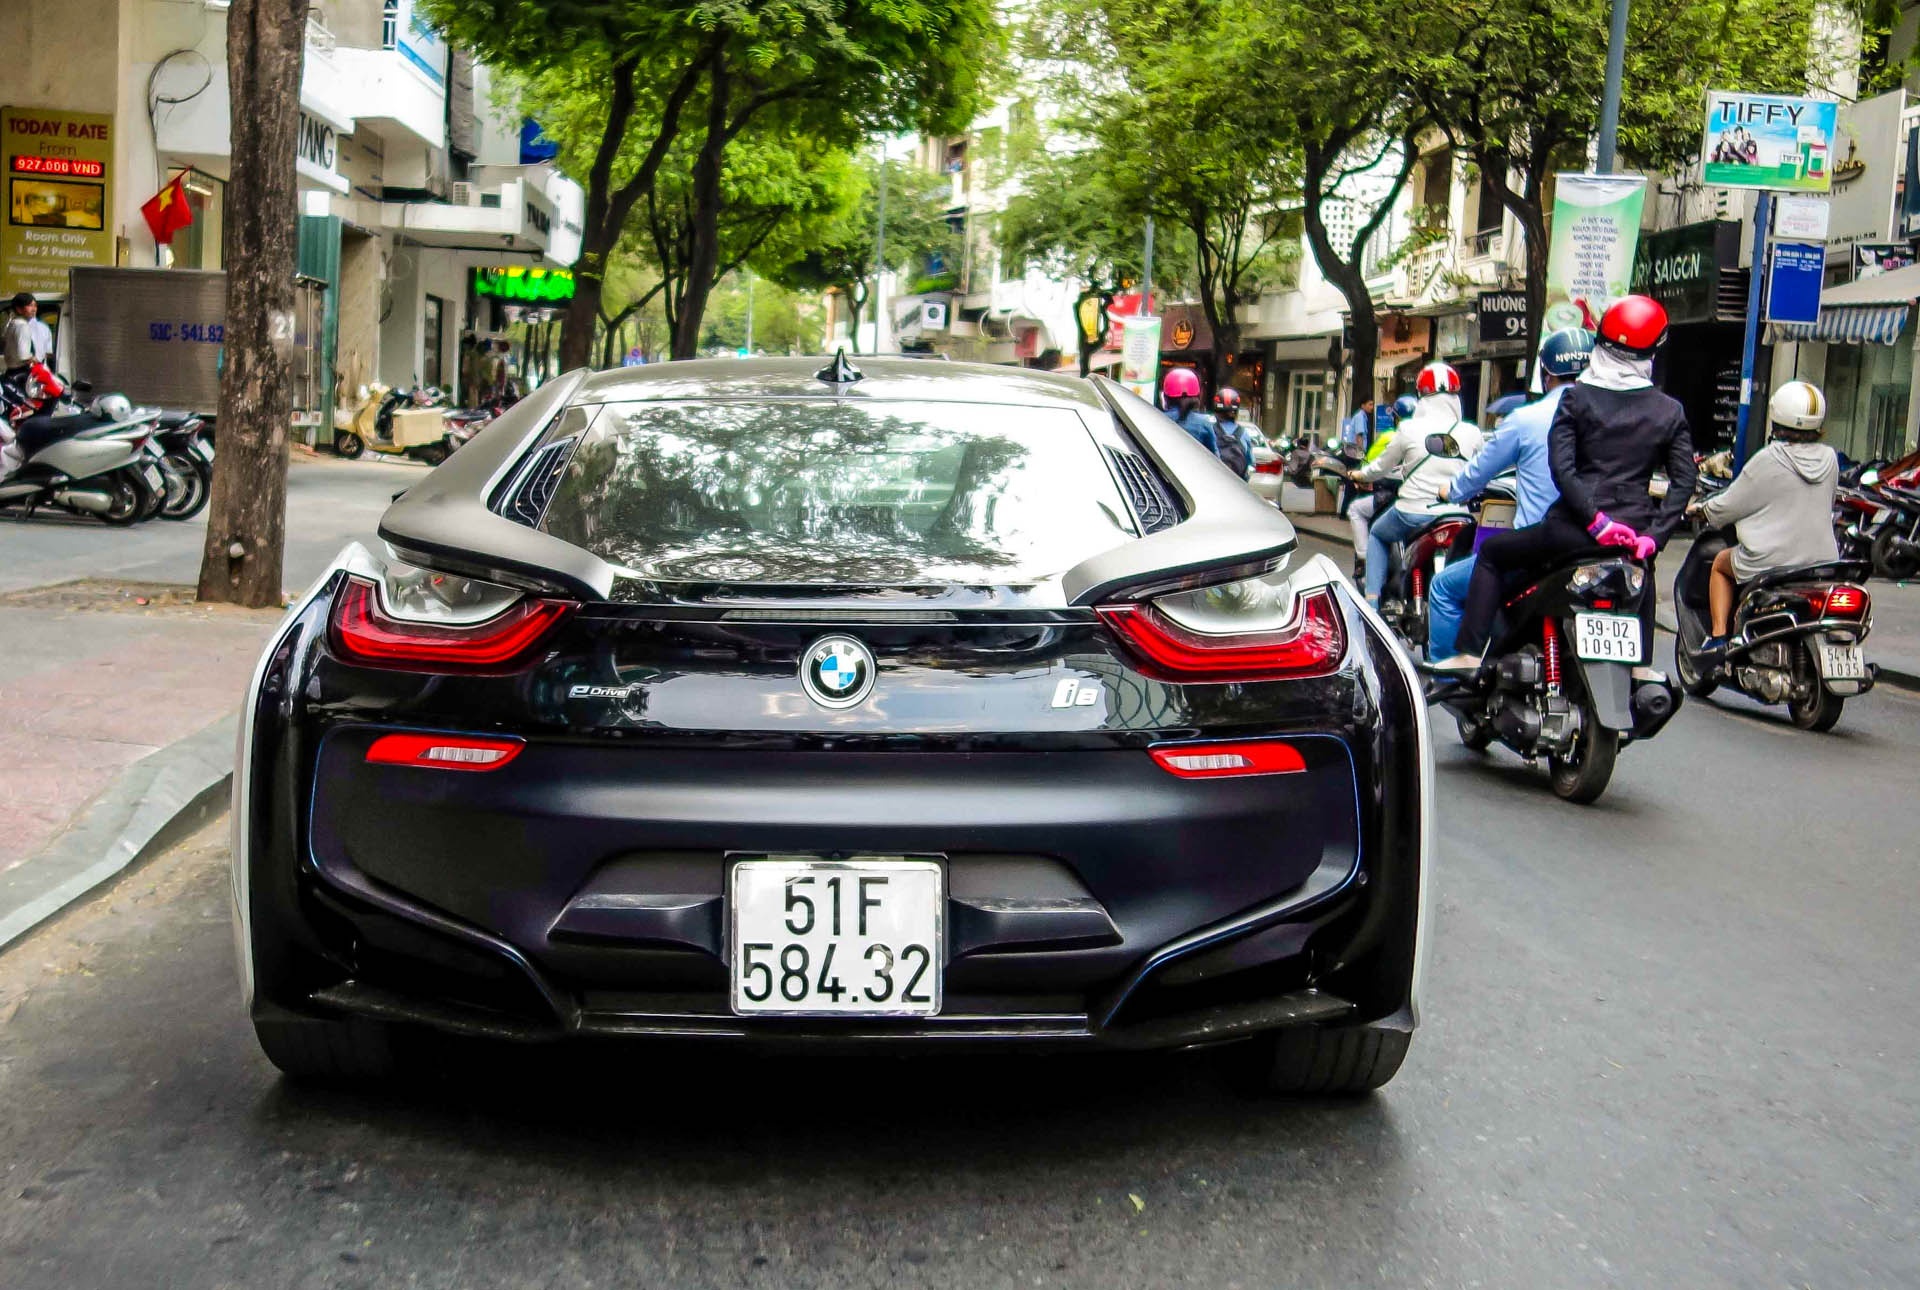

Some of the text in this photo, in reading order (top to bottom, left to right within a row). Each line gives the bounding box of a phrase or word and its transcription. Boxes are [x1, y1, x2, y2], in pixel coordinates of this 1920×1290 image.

[1718, 100, 1804, 126] TIFFY
[9, 117, 108, 139] TODAY RATE
[39, 141, 77, 156] From
[18, 159, 101, 175] 927.000 VND
[25, 230, 87, 245] Room Only
[27, 247, 39, 256] or
[41, 246, 48, 257] 2
[51, 247, 94, 259] Persons
[1654, 250, 1701, 285] SAIGON
[1581, 638, 1636, 657] 109.13
[1051, 678, 1099, 708] i8
[785, 876, 889, 936] 51F
[743, 943, 931, 1003] 584.32
